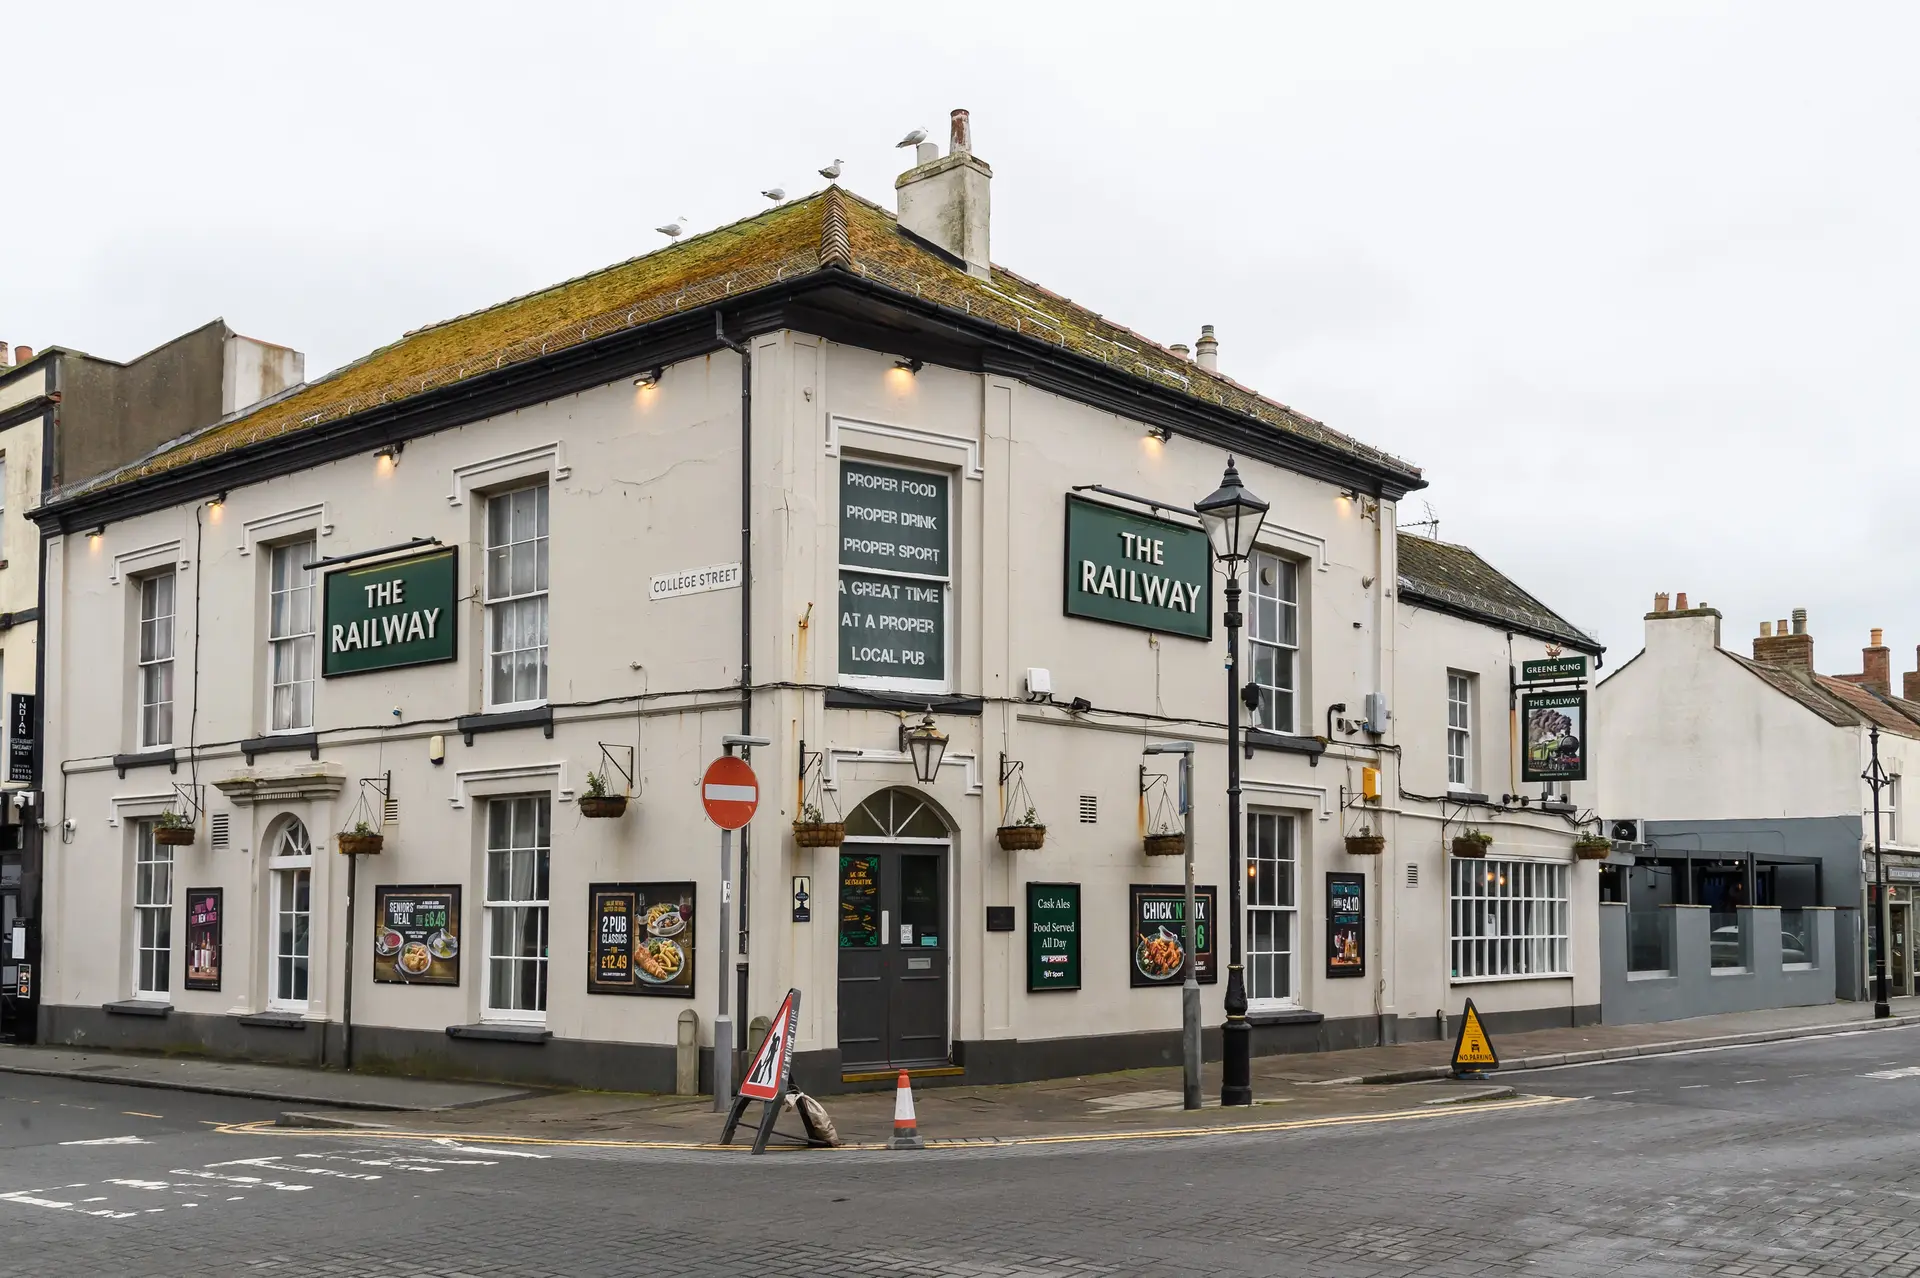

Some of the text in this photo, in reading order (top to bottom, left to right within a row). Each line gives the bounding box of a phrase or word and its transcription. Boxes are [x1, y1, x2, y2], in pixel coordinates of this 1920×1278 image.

[847, 471, 937, 498] PROPER FOOD
[846, 504, 937, 530] PROPER DRINK
[843, 537, 940, 562] PROPER SPORT
[1121, 531, 1164, 565] THE
[653, 568, 738, 593] COLLEGE STREET
[1082, 560, 1201, 613] RAILWAY
[364, 579, 404, 608] THE
[839, 581, 939, 604] A GREAT TIME
[331, 607, 440, 653] RAILWAY
[841, 612, 934, 633] AT A PROPER
[851, 646, 925, 666] LOCAL PUB
[1526, 663, 1581, 674] GREENE KING
[1529, 697, 1580, 707] THE RAILWAY
[389, 902, 415, 913] SENIORS'
[1038, 898, 1071, 909] Cask Ales
[1143, 902, 1172, 919] CHICK
[1342, 896, 1359, 911] £4.10
[394, 913, 411, 925] DEAL
[602, 916, 627, 932] 2 PUB
[1033, 922, 1075, 932] Food Served
[601, 934, 627, 944] CLASSICS
[1042, 938, 1067, 950] All Day
[601, 955, 627, 969] £12.49
